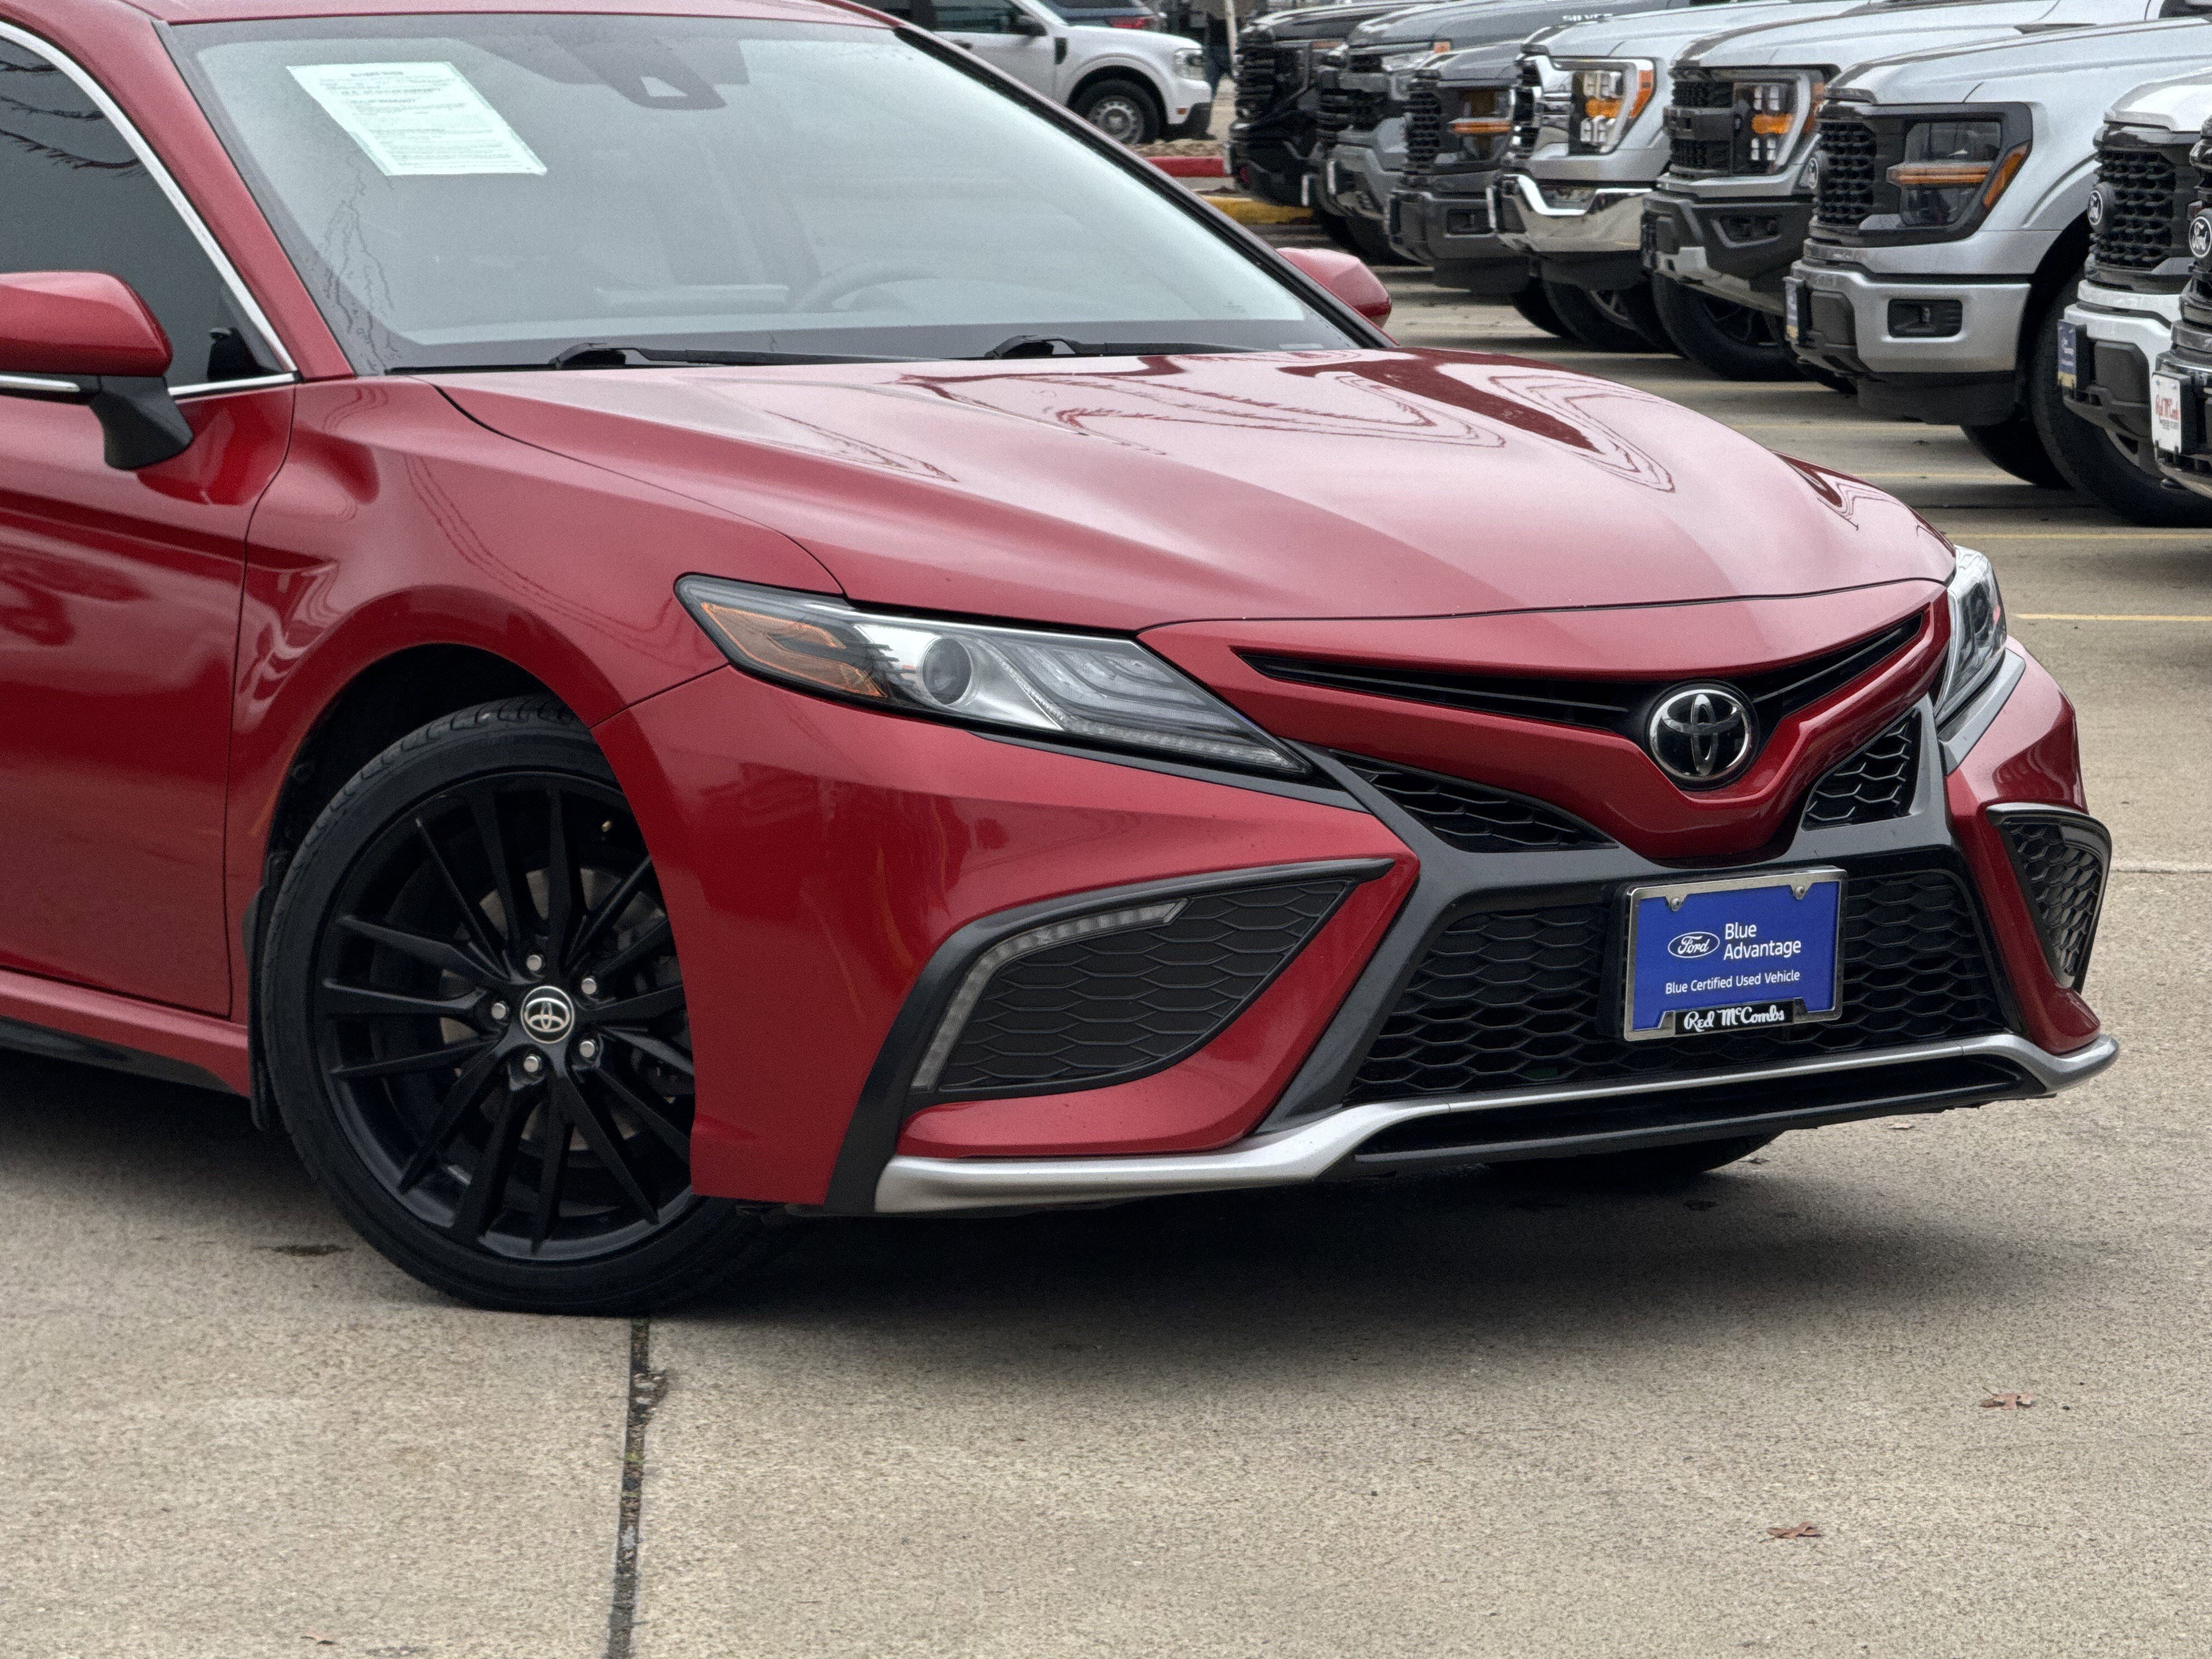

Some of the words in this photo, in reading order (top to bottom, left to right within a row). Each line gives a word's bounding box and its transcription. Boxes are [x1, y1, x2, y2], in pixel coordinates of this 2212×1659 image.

[1725, 922, 1757, 940] Blue
[1677, 935, 1710, 955] Ford
[1723, 940, 1802, 960] Advantage
[1665, 983, 1688, 994] Blue
[1691, 976, 1733, 991] Certified
[1736, 973, 1761, 986] Used
[1764, 969, 1801, 984] Vehicle
[1684, 1011, 1715, 1032] Red
[1717, 1005, 1785, 1026] McCombs
